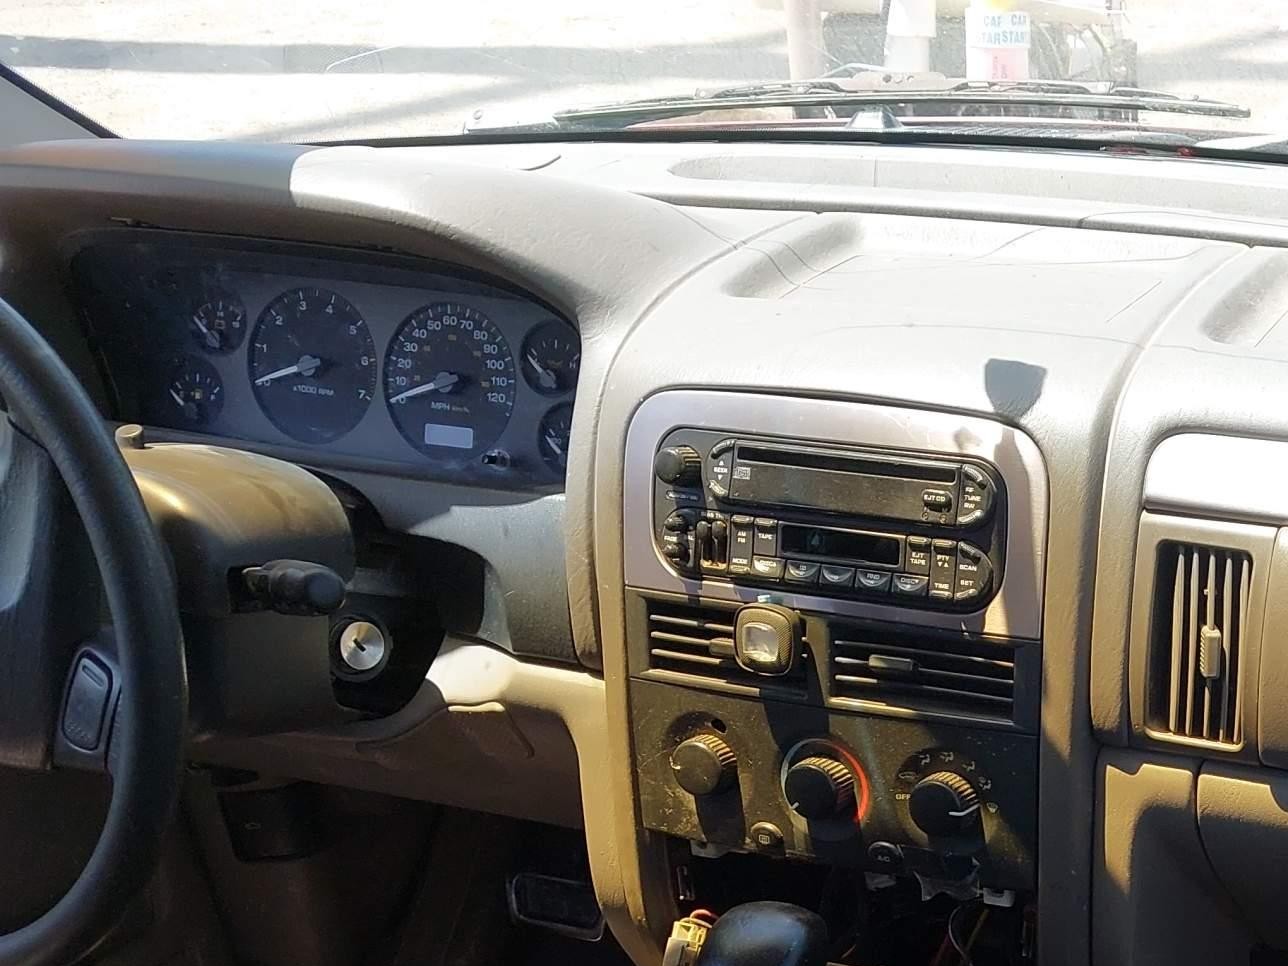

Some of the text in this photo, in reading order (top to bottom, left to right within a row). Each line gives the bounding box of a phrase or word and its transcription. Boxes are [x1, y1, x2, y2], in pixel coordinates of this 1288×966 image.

[300, 301, 307, 310] 3
[325, 304, 333, 314] 4
[275, 316, 283, 325] 2
[426, 320, 441, 330] 50
[442, 316, 457, 325] 60
[460, 320, 474, 330] 70
[349, 326, 358, 335] 5
[412, 329, 427, 338] 40
[473, 330, 488, 340] 80
[262, 344, 267, 352] 1
[403, 342, 418, 352] 30
[483, 344, 498, 354] 90
[360, 356, 369, 366] 6
[397, 359, 412, 368] 20
[486, 360, 504, 370] 100
[395, 376, 406, 386] 10
[491, 376, 507, 386] 110
[358, 390, 366, 399] 7
[487, 393, 506, 402] 120
[431, 402, 450, 410] MPH
